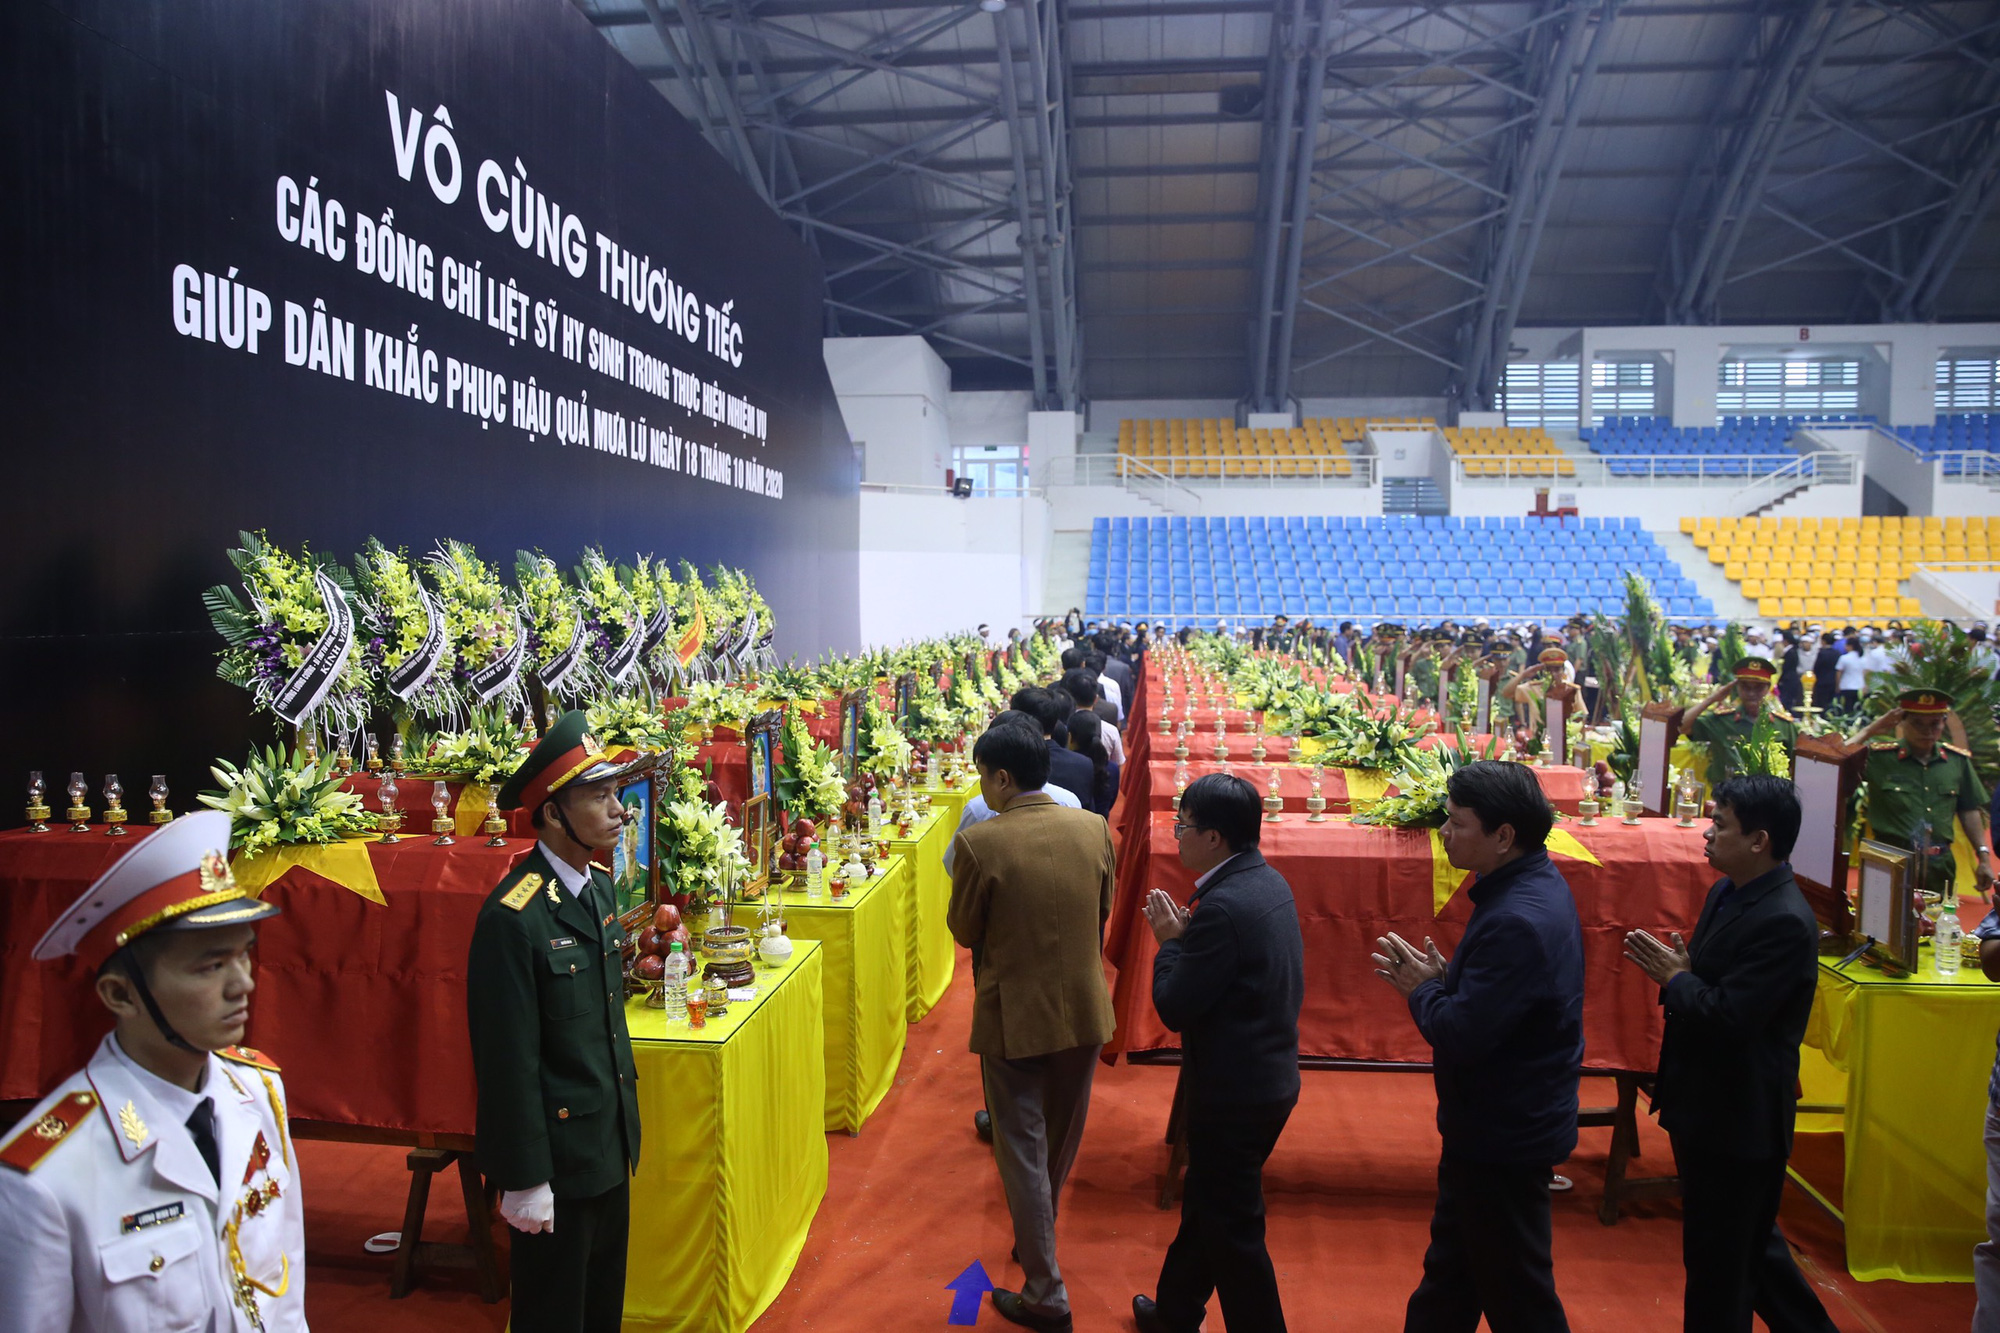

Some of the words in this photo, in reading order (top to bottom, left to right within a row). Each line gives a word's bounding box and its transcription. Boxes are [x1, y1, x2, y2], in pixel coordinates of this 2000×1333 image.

[277, 175, 345, 262] CÁC
[356, 206, 434, 301] ĐỒNG
[442, 255, 482, 320] CHÍ
[488, 277, 530, 347] LIỆT
[535, 299, 558, 353] SỸ
[563, 314, 584, 364] HY
[588, 328, 625, 382] SINH
[628, 346, 669, 400] TRONG
[672, 366, 700, 418] THỰC
[702, 380, 725, 428] HIỆN
[727, 394, 755, 440] NHIỆM
[757, 408, 767, 447] VỤ
[386, 89, 462, 205] VÔ
[477, 156, 588, 279] CÙNG
[596, 232, 700, 344] THƯƠNG
[705, 299, 743, 368] TIẾC
[173, 264, 271, 355] GIÚP
[285, 298, 355, 381] DÂN
[365, 324, 439, 404] KHẮC
[447, 357, 506, 431] PHỤC
[513, 375, 551, 443] HẬU
[556, 389, 590, 447] QUẢ
[594, 408, 628, 458] MƯA
[631, 417, 647, 462] LŨ
[650, 425, 682, 472] NGÀY
[685, 440, 698, 476] 18
[700, 442, 731, 486] THÁNG
[733, 457, 744, 489] 10
[745, 456, 764, 495] NĂM
[765, 468, 783, 500] 2020
[320, 644, 342, 675] KÍNH
[476, 667, 496, 685] QUÂN
